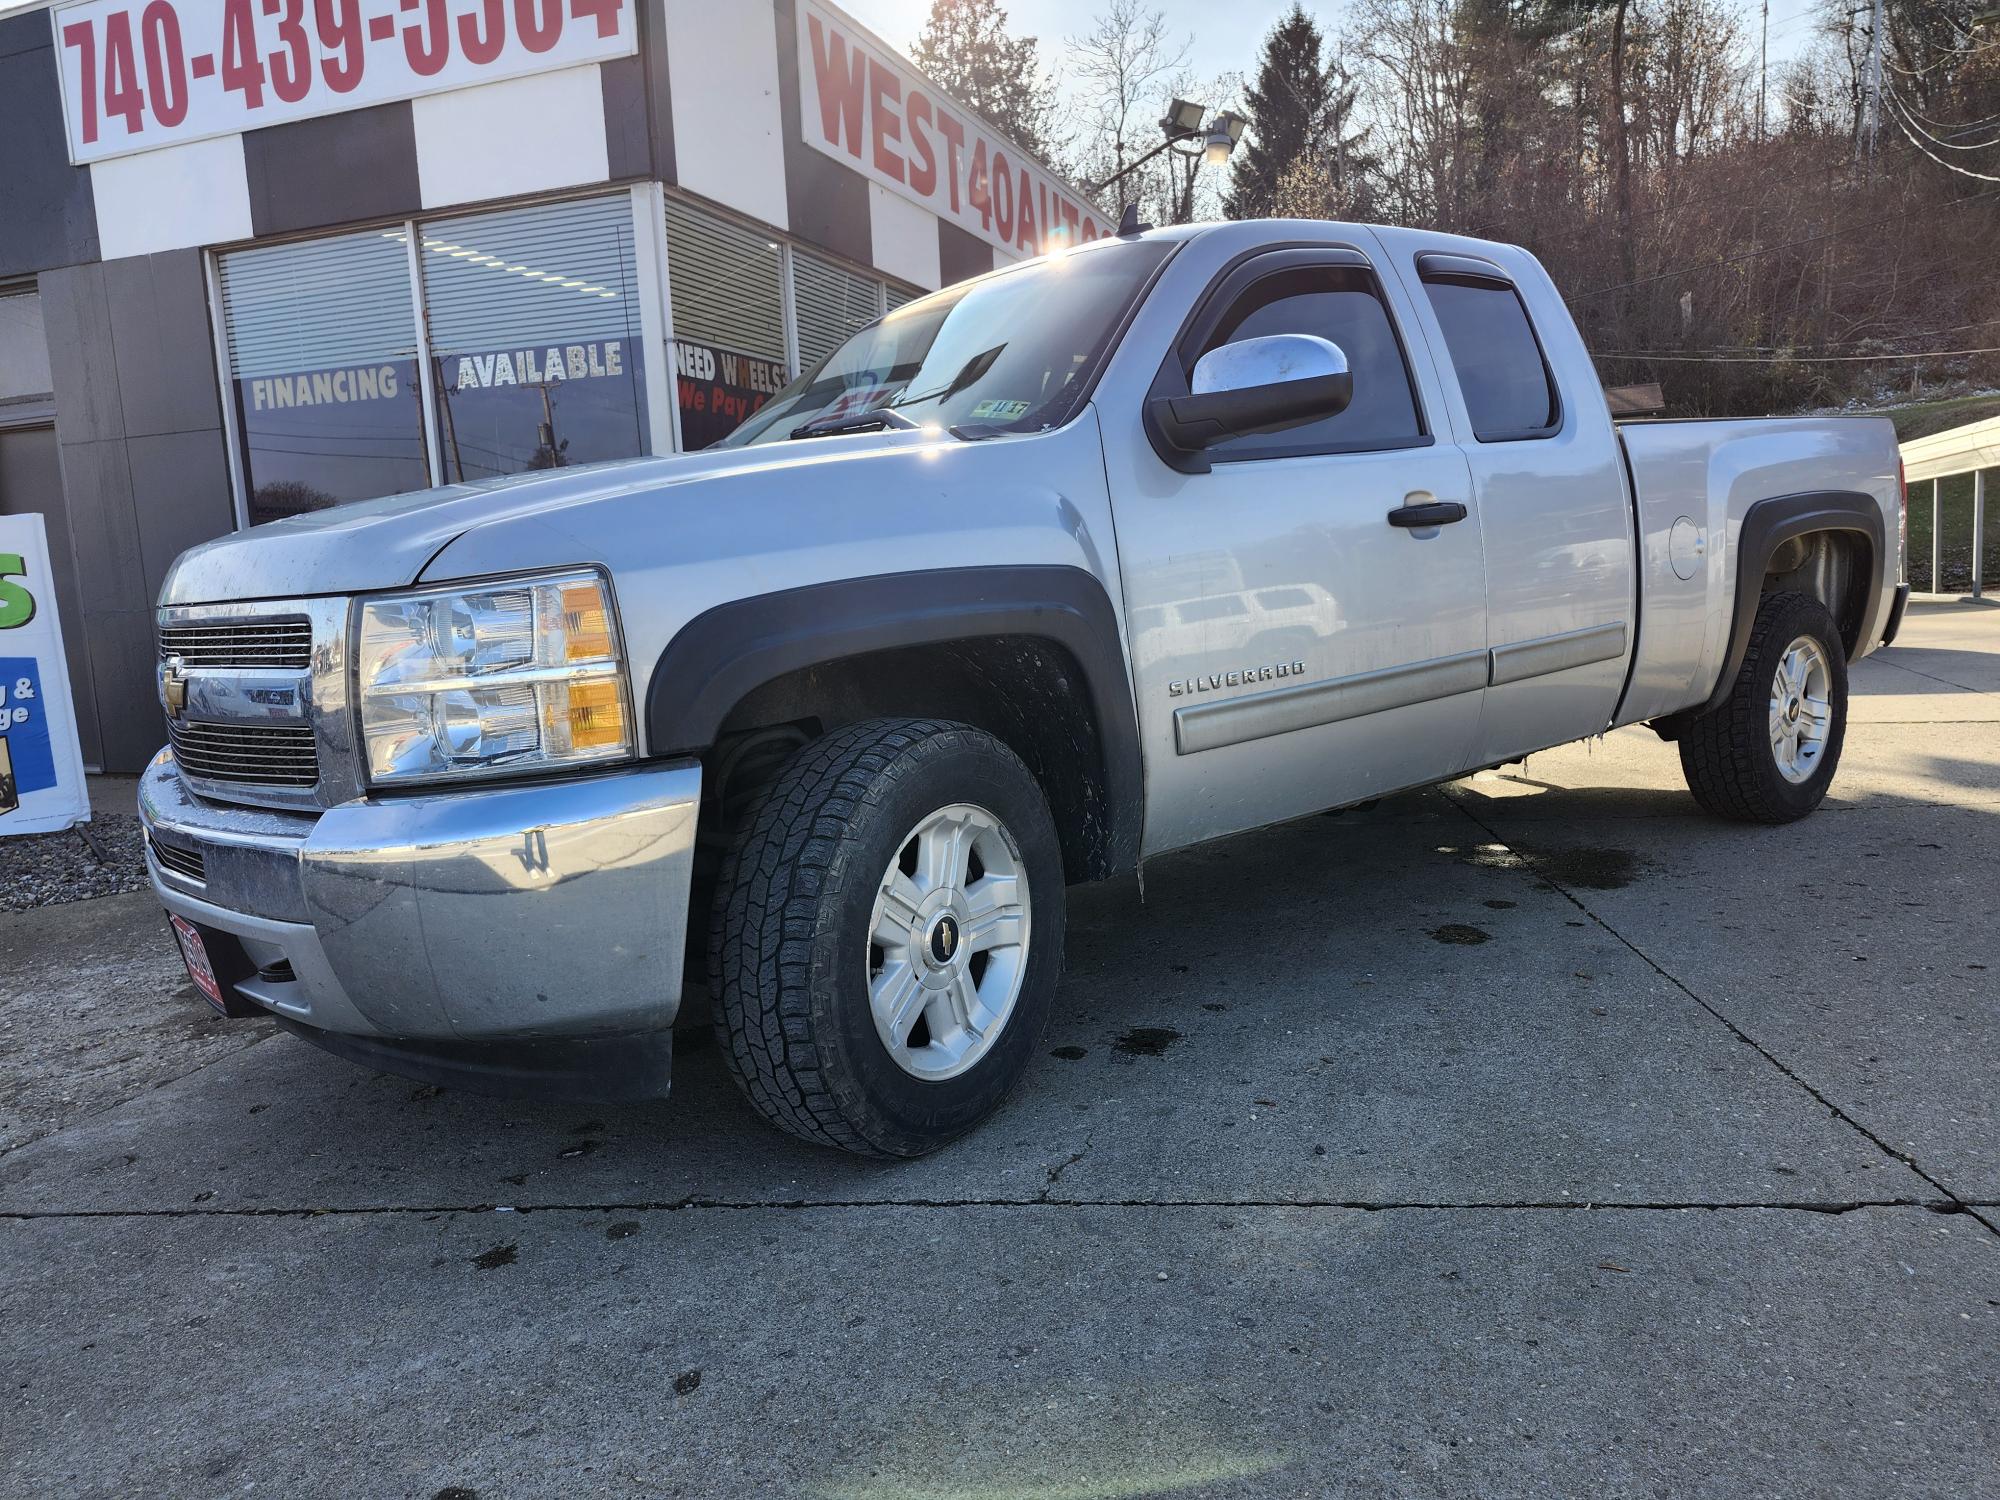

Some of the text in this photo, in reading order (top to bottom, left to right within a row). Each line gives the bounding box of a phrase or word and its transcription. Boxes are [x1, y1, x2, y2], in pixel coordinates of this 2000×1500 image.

[807, 12, 964, 215] WEST
[252, 341, 624, 411] FINANCING AVAILABLE
[675, 343, 716, 381] NEED
[678, 379, 705, 411] We
[712, 387, 747, 422] Pay
[1169, 660, 1306, 697] SILVERADO
